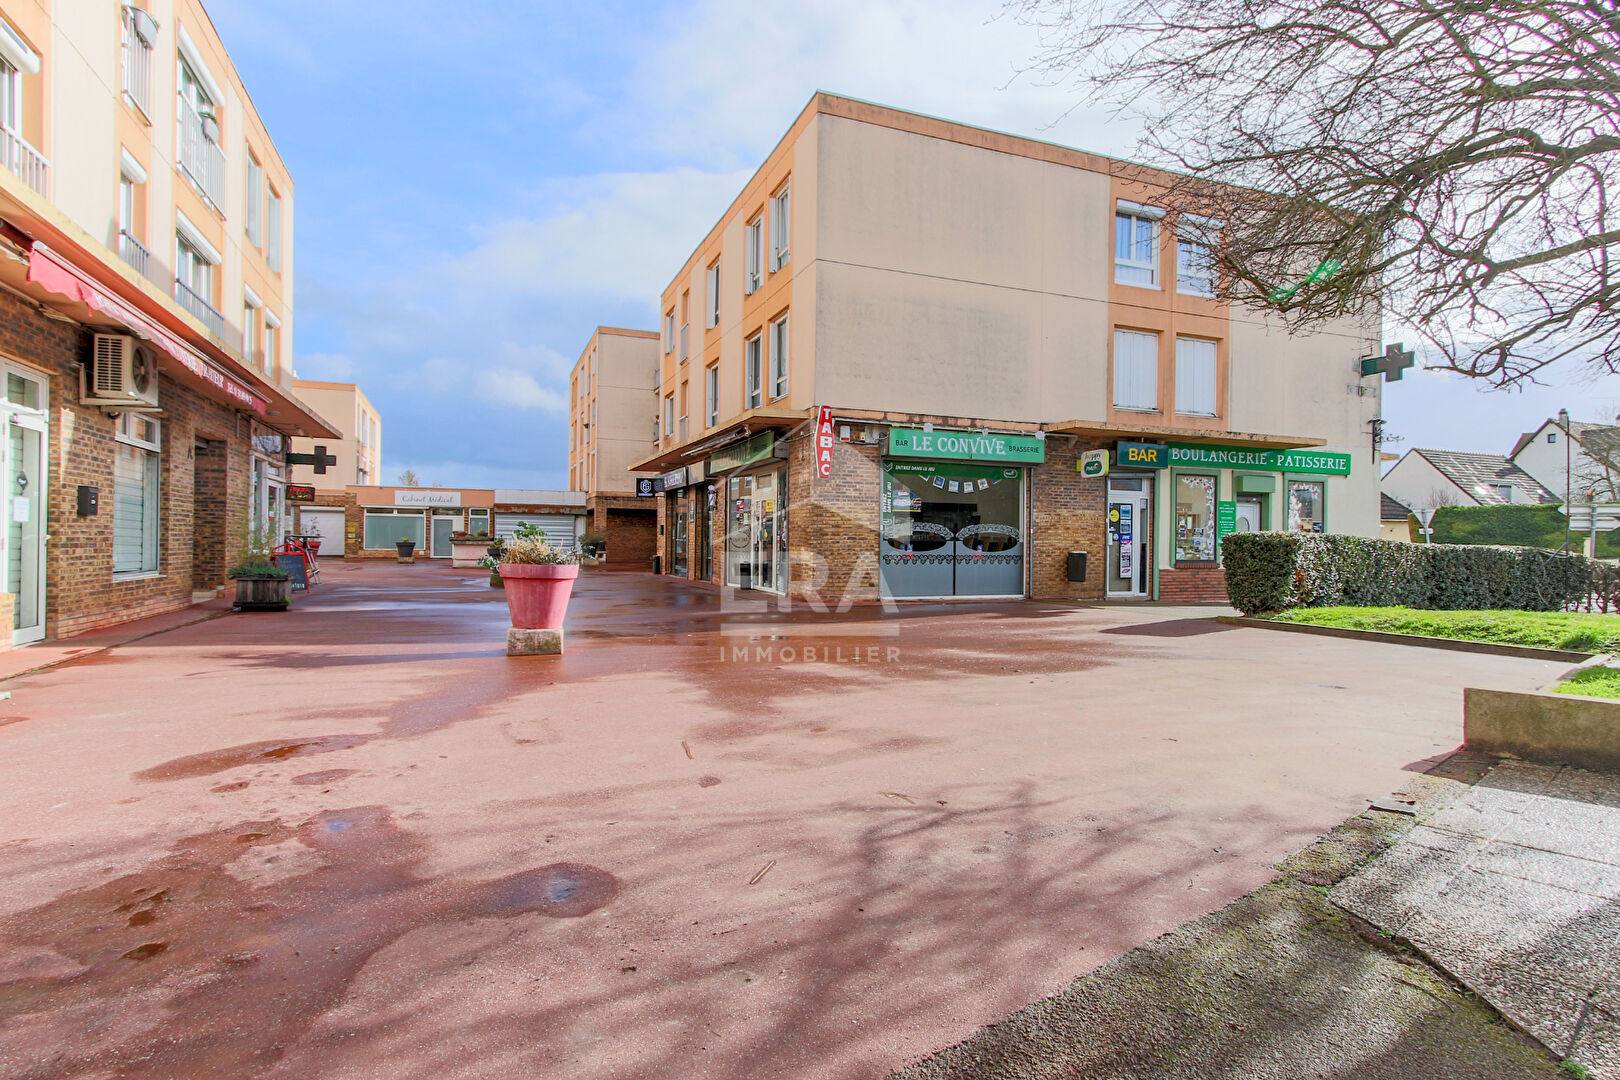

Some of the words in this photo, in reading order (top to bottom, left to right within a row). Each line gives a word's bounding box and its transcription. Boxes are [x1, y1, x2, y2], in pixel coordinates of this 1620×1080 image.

[820, 408, 833, 475] TABAC
[895, 439, 908, 447] BAR
[912, 435, 932, 452] LE
[937, 437, 1006, 455] CONVIVE
[1008, 445, 1040, 454] BRASSERIE
[1128, 447, 1157, 462] BAR
[1171, 447, 1267, 465] BOULANGERIE
[1277, 454, 1347, 470] PATISSERIE
